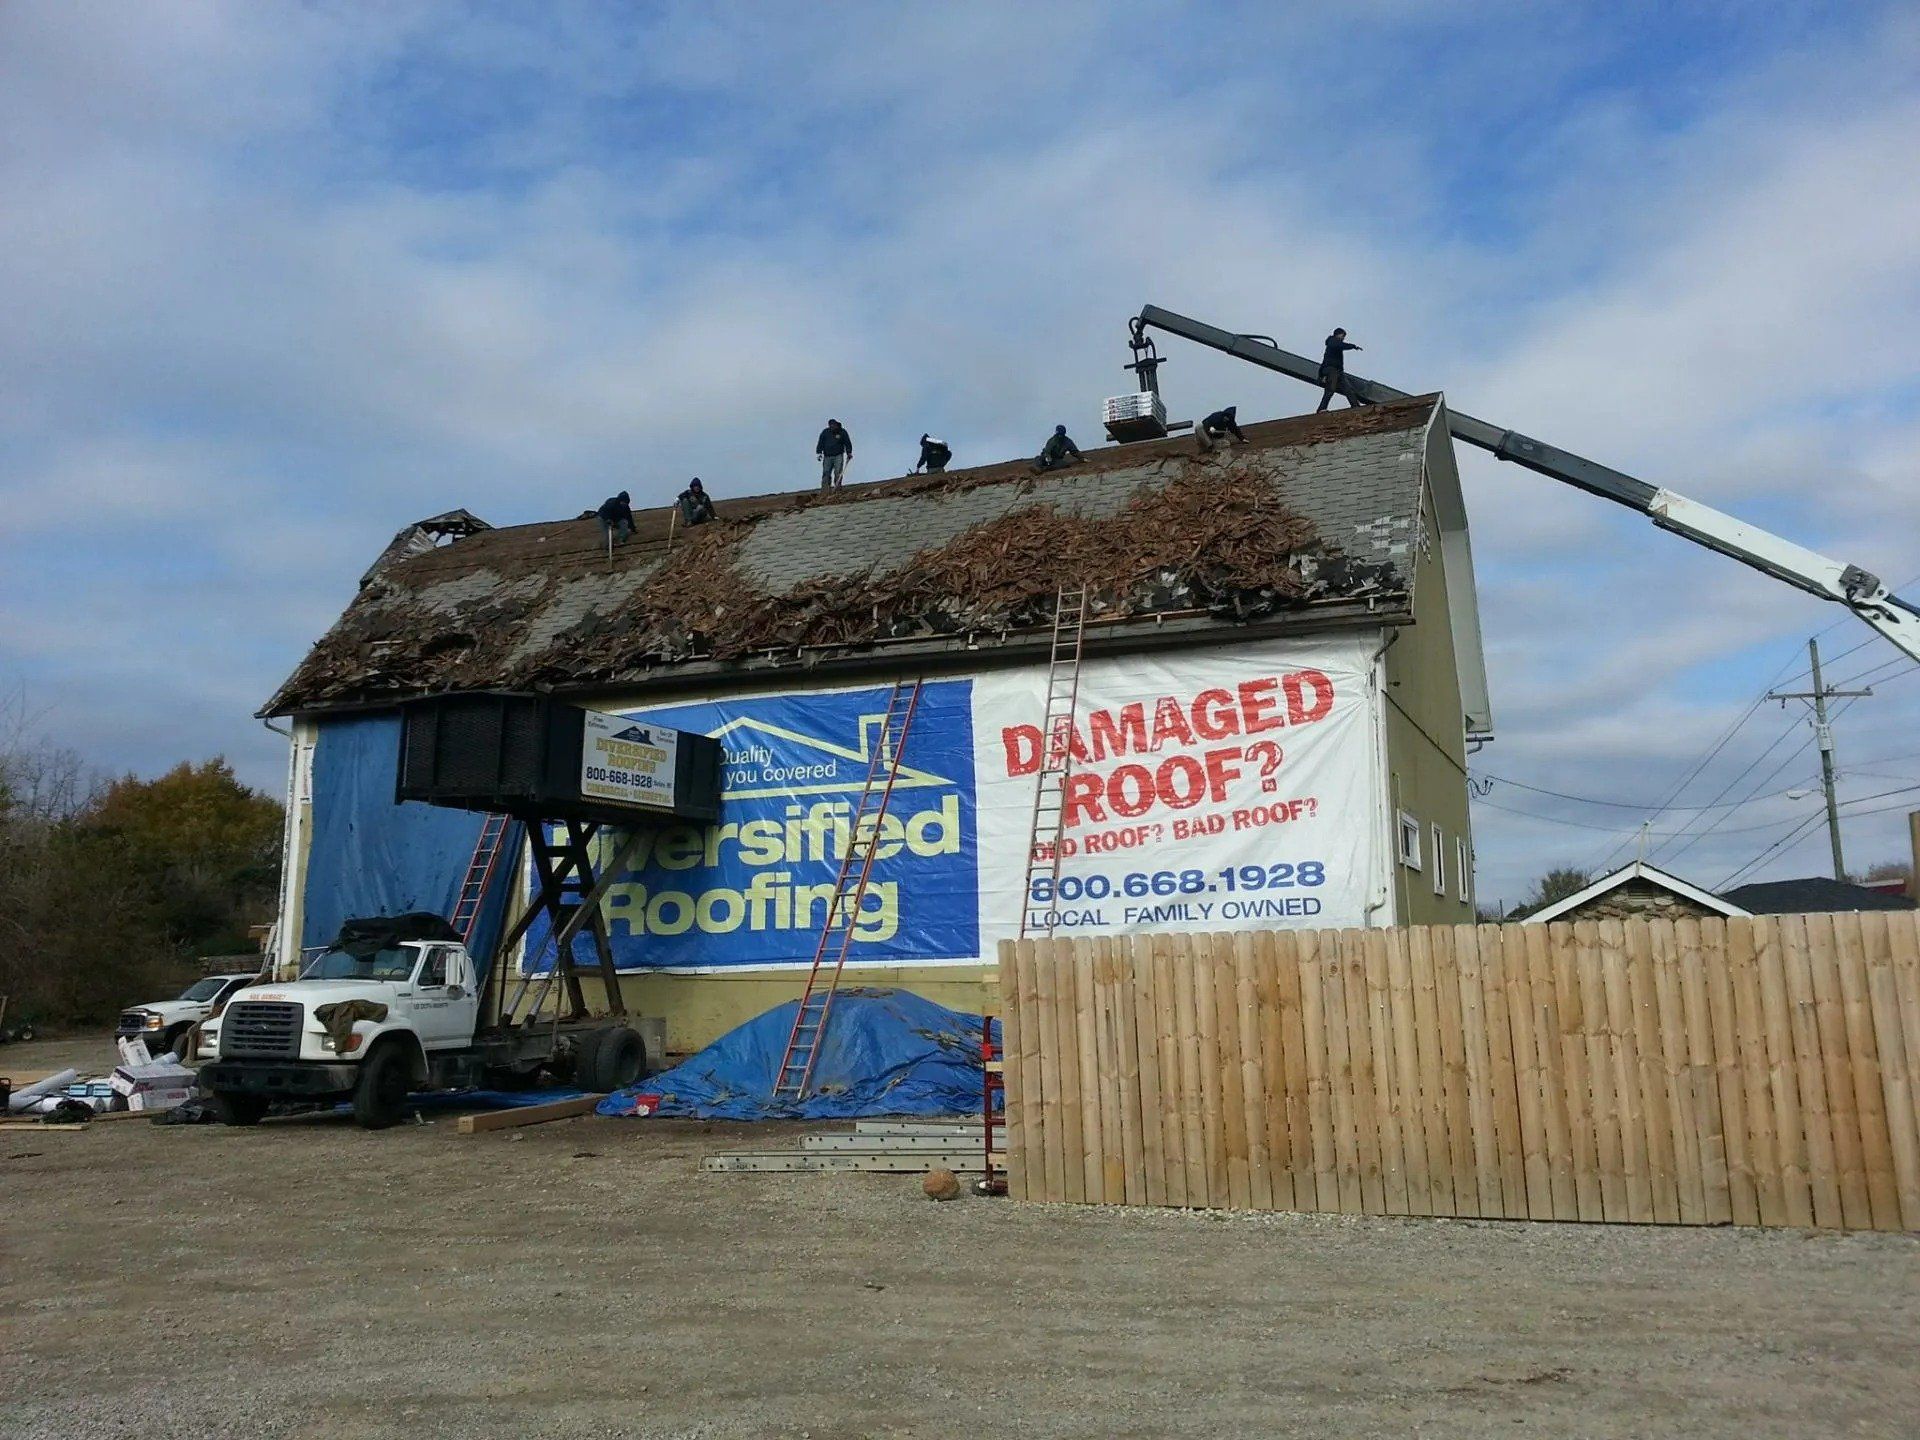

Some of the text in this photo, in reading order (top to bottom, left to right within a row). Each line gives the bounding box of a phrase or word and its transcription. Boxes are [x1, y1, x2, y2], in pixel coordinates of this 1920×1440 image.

[1002, 671, 1334, 776] DAMAGED
[586, 766, 653, 789] 800-668-1928
[726, 758, 837, 790] you covered
[1058, 740, 1284, 828] ROOF?
[1085, 823, 1165, 855] ROOF?
[1173, 813, 1226, 841] BAD
[1233, 798, 1319, 832] ROOF?
[1031, 860, 1326, 902] 800.668.1928
[599, 871, 899, 943] Roofing
[1031, 897, 1322, 928] LOCAL FAMILY OWNED
